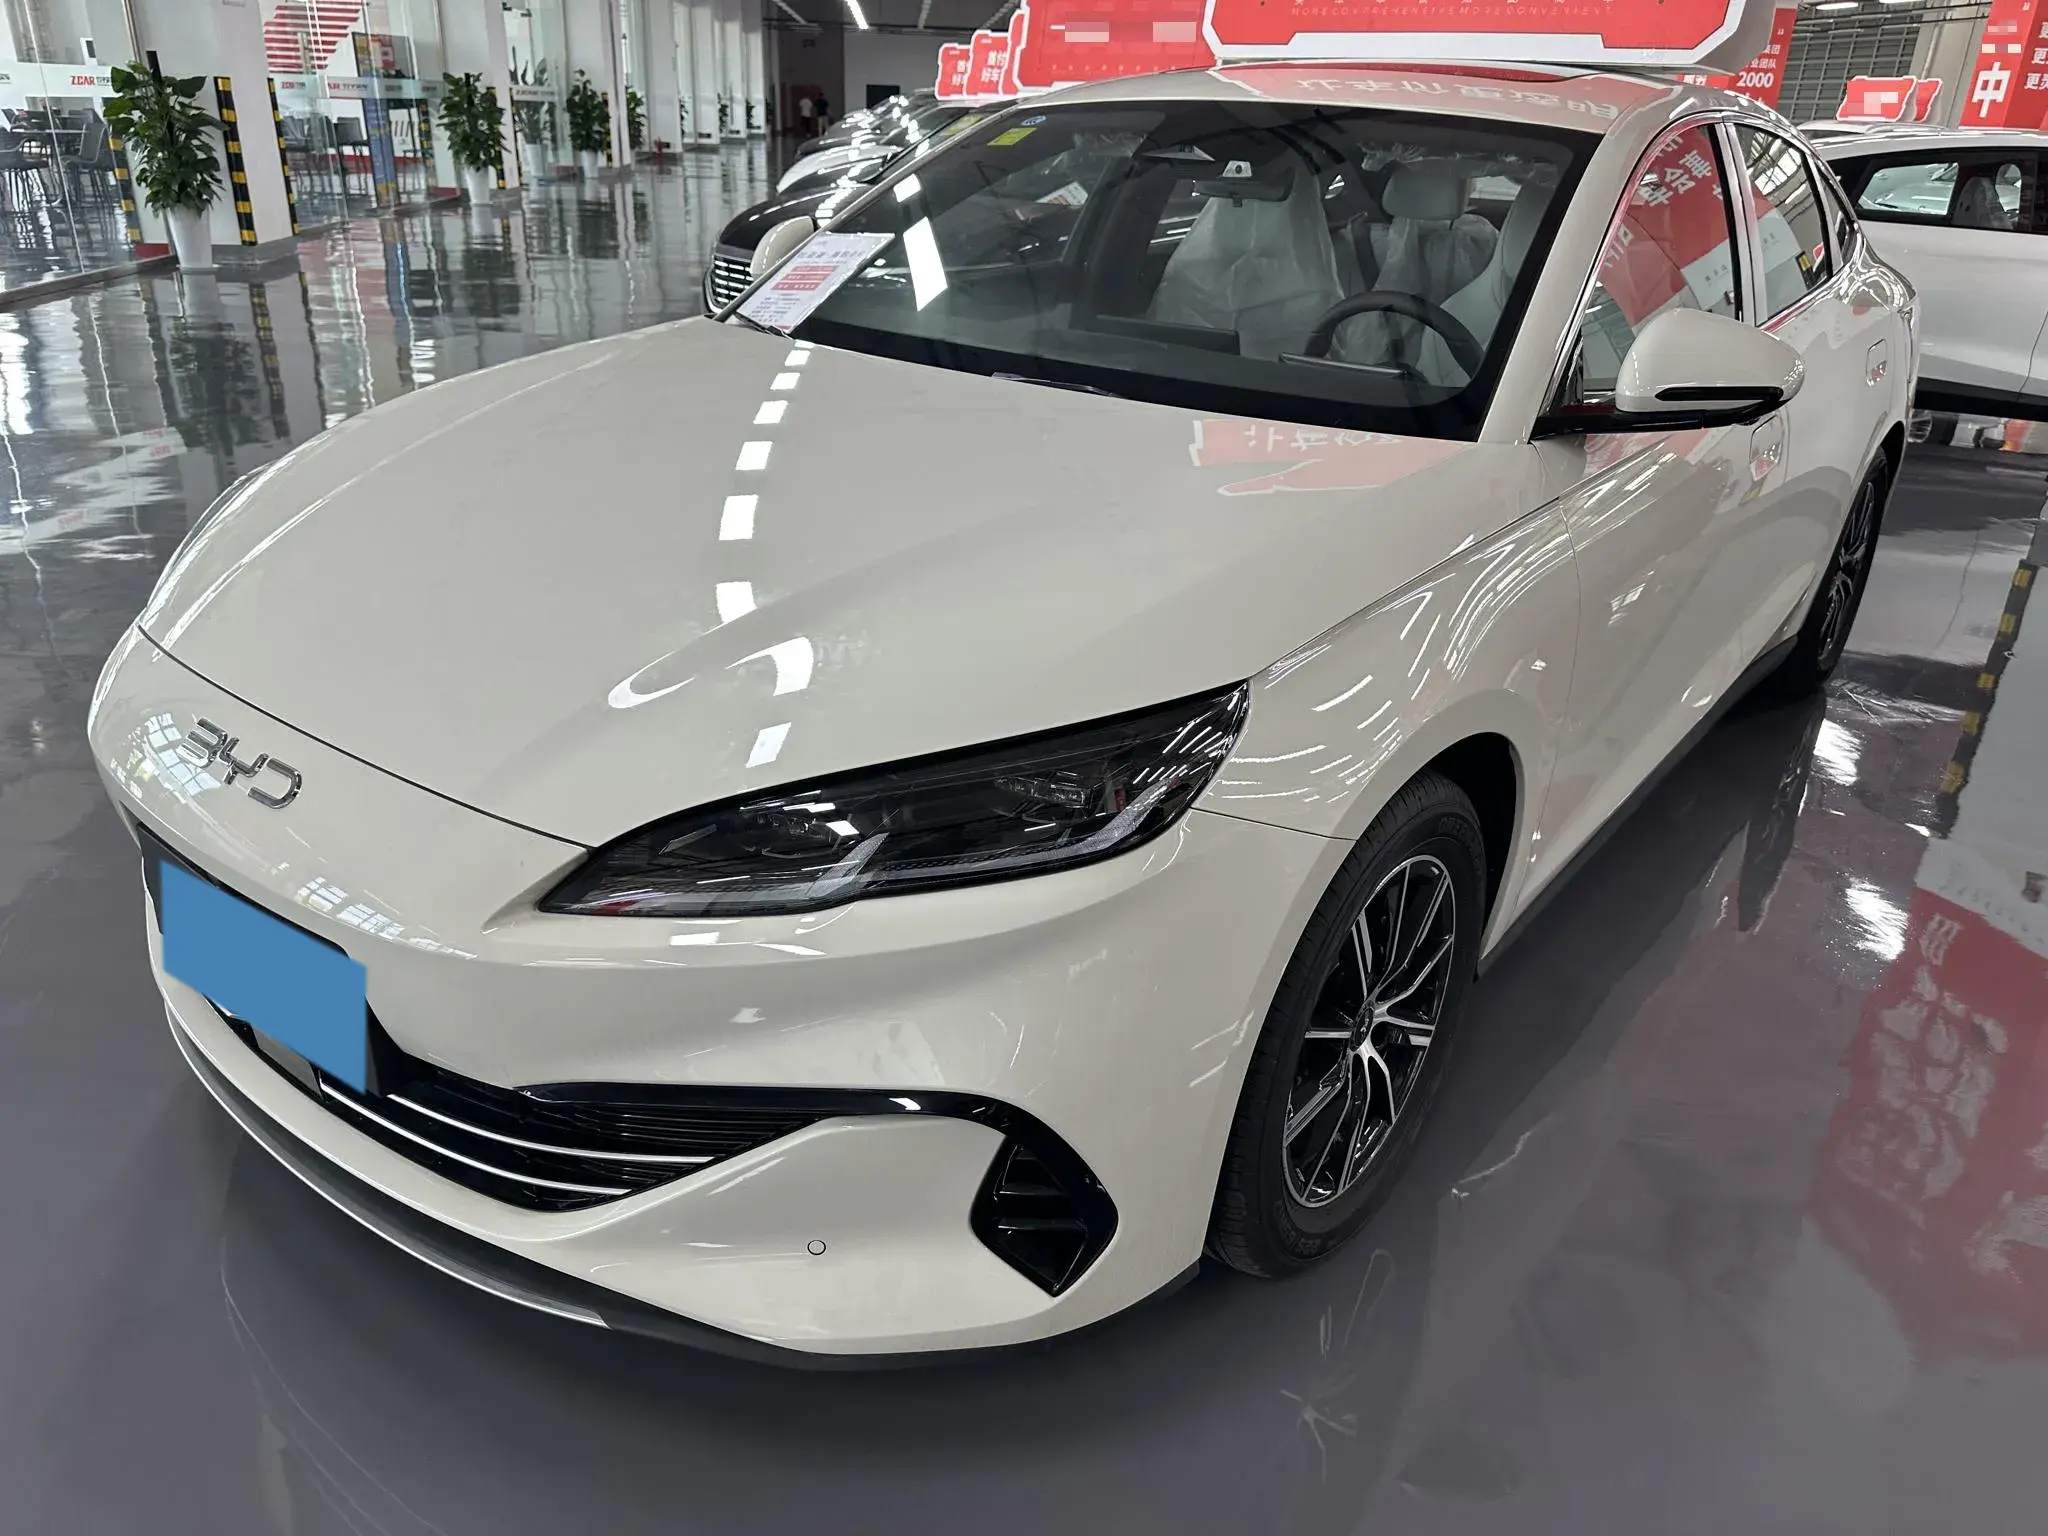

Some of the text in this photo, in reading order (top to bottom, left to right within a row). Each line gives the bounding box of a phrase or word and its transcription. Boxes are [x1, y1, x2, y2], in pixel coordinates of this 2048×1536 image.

[1746, 58, 1776, 69] 业团队
[70, 75, 96, 86] ZCAR
[1736, 71, 1774, 88] 2000
[1972, 61, 2011, 118] 中
[176, 717, 303, 809] BYD
